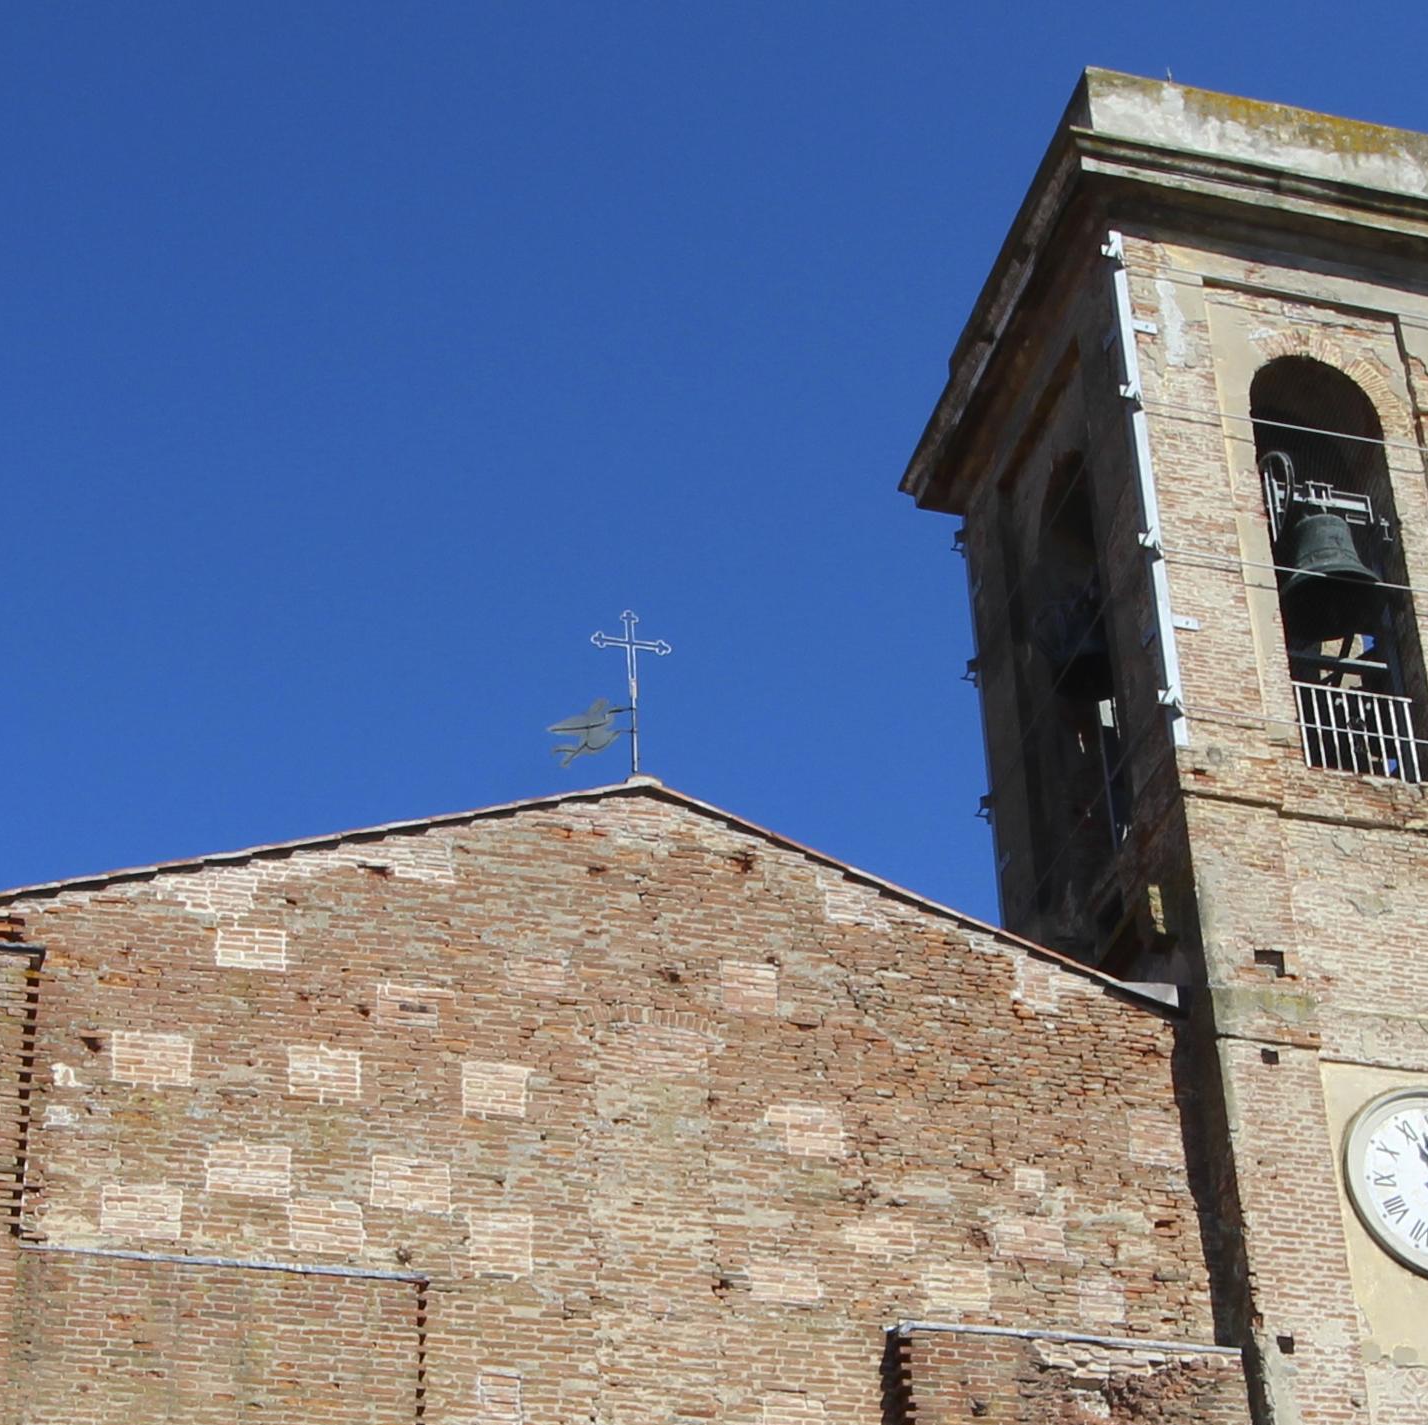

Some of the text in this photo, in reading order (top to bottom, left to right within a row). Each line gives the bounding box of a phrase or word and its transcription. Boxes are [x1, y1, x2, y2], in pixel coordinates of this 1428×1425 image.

[1395, 1120, 1418, 1145] XI
[1376, 1140, 1400, 1162] X
[1373, 1170, 1397, 1188] IX
[1383, 1195, 1409, 1224] VIII
